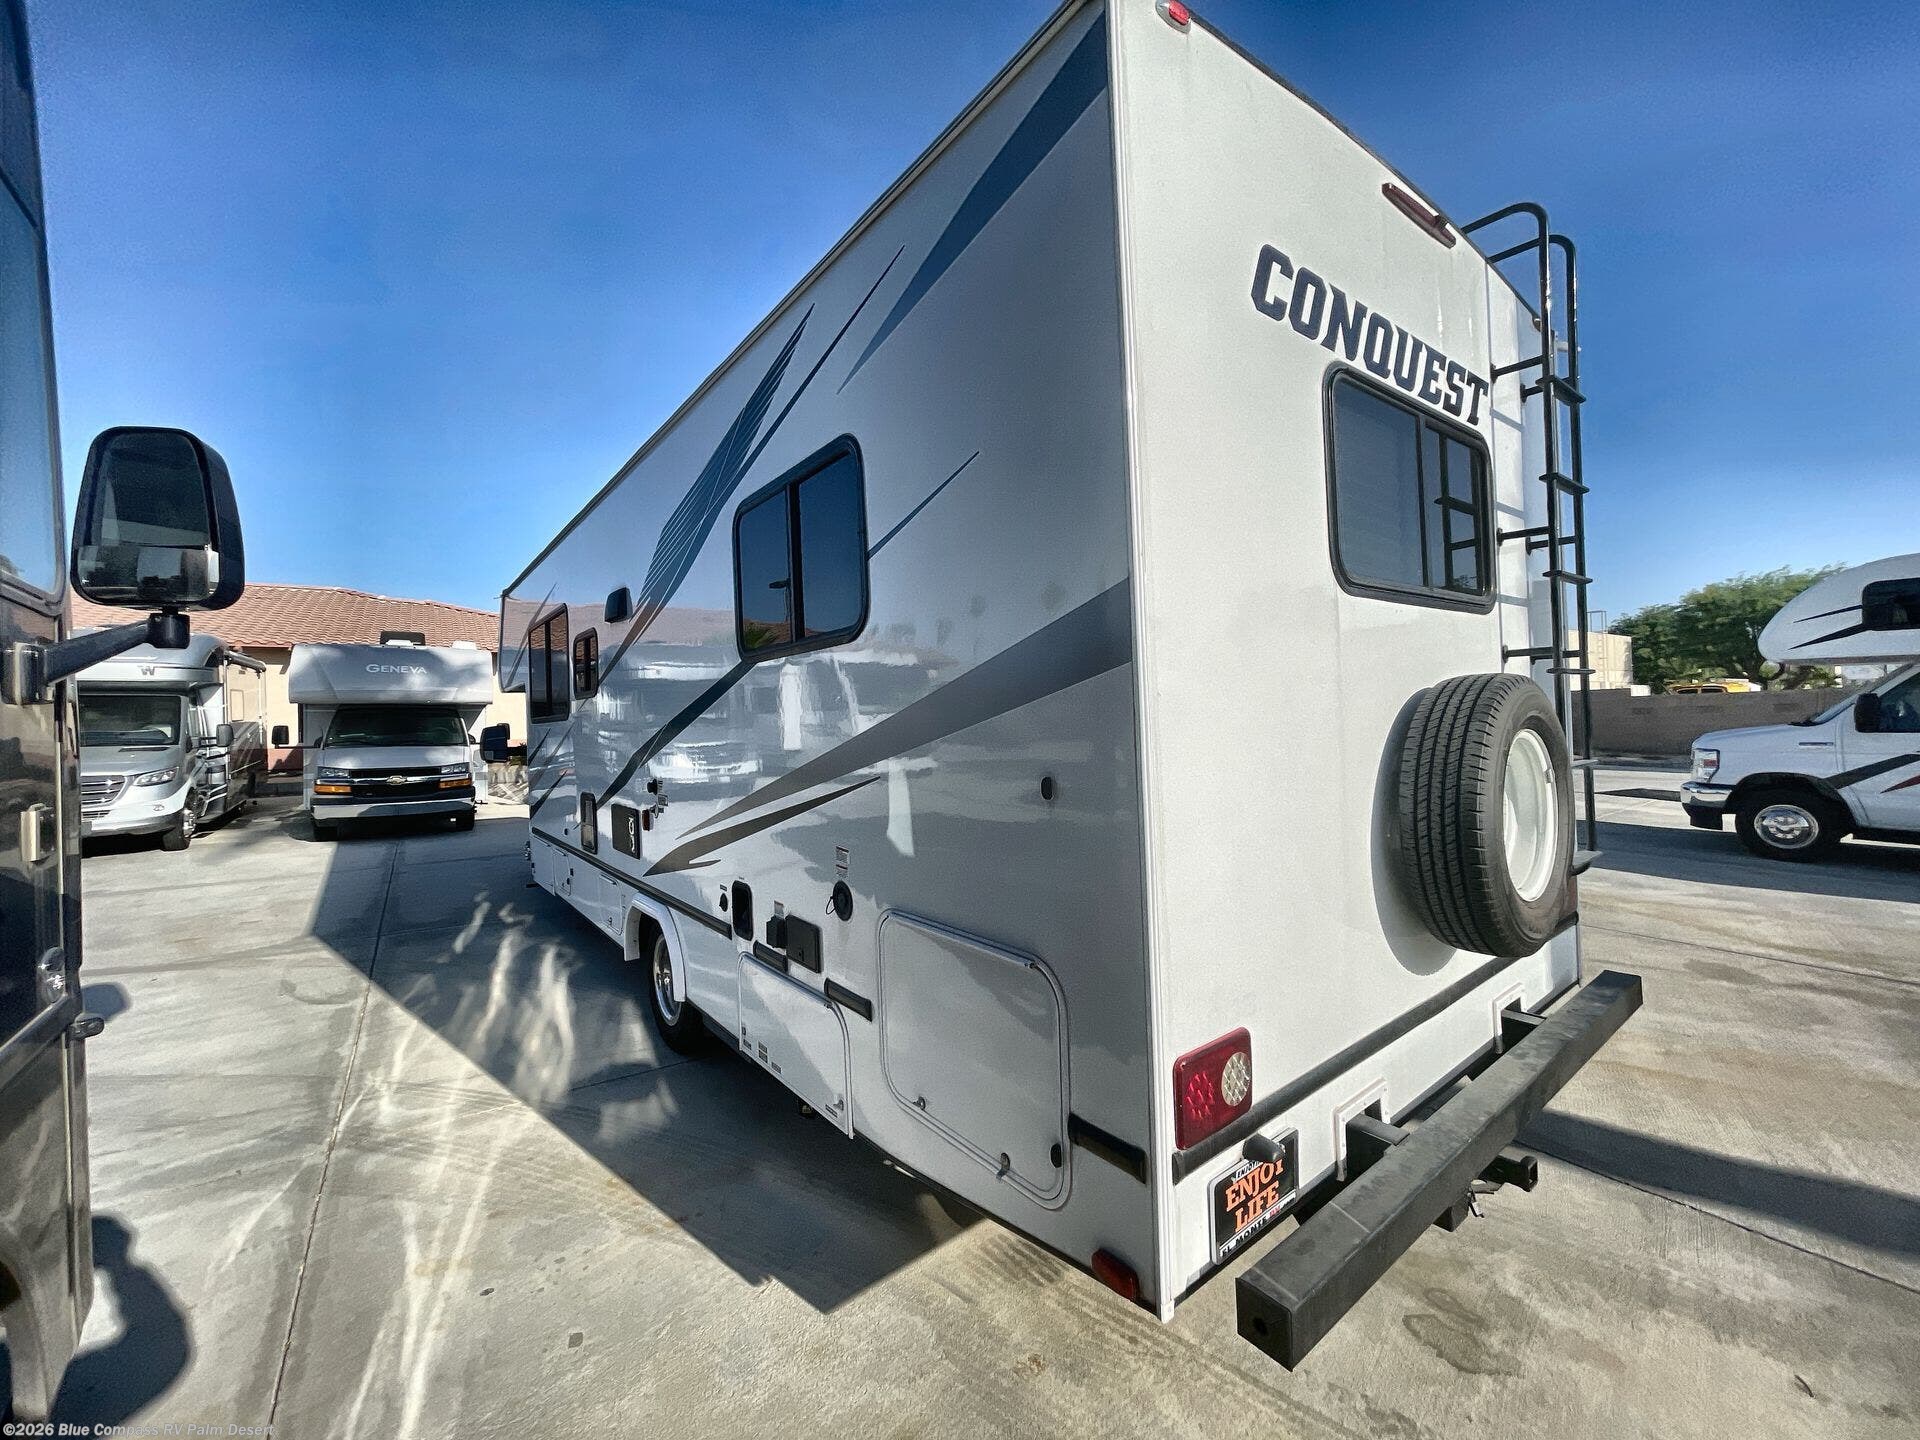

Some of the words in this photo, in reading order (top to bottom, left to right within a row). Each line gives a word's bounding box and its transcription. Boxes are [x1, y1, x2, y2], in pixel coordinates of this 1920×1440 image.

[1250, 243, 1490, 426] CONQUEST
[365, 663, 428, 674] GENEVA
[1235, 1180, 1279, 1233] LIFE
[1235, 1216, 1268, 1247] MONTE
